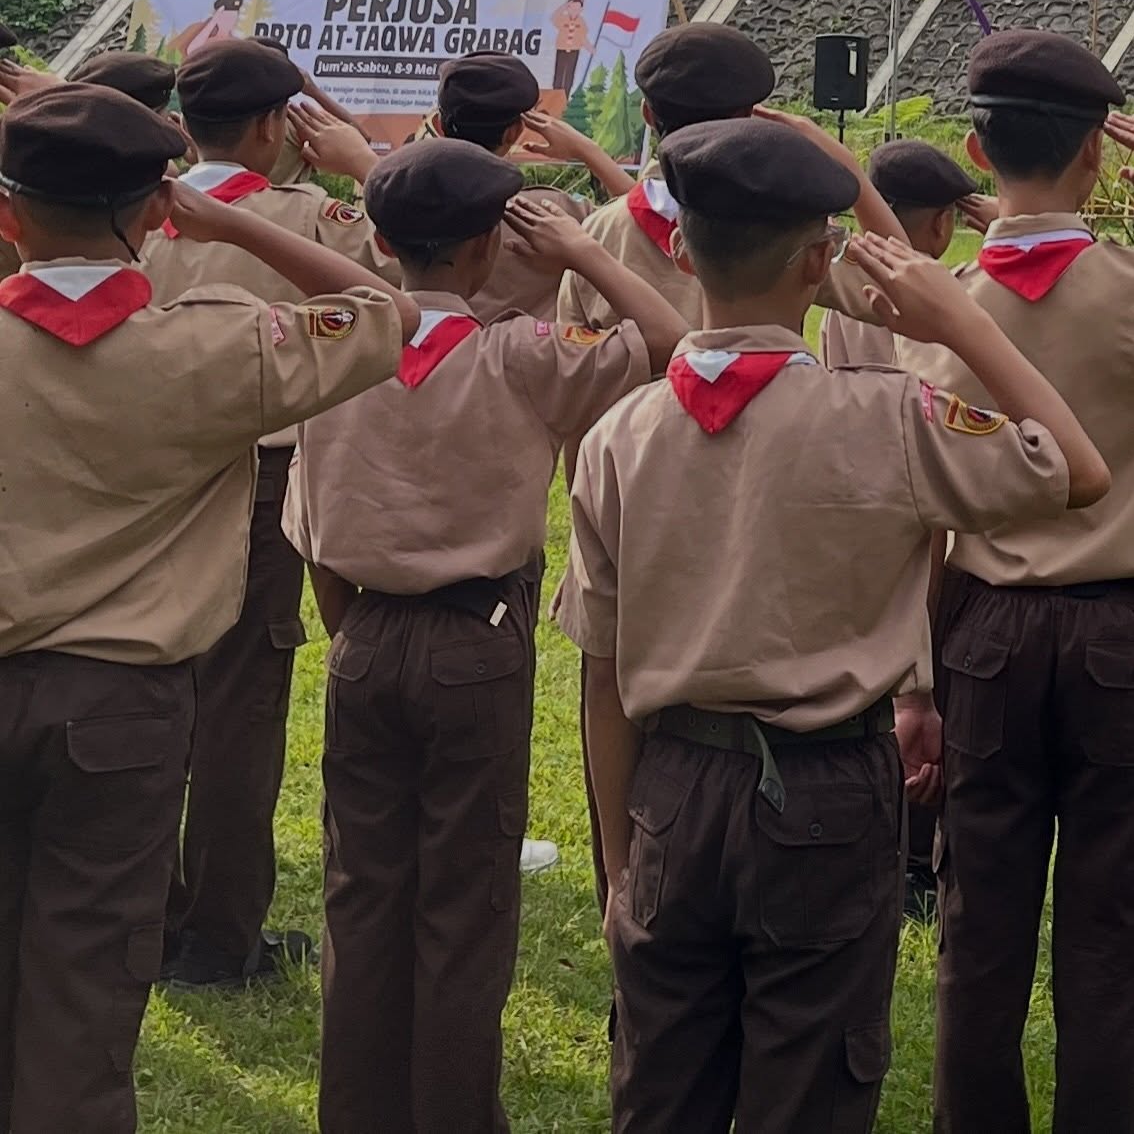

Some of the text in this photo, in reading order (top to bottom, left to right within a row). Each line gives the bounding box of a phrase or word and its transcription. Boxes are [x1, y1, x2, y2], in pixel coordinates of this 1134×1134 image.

[317, 24, 435, 53] AT-TAQWA
[443, 27, 542, 56] GRABAG
[394, 62, 413, 75] 8-9
[414, 63, 437, 75] Mei
